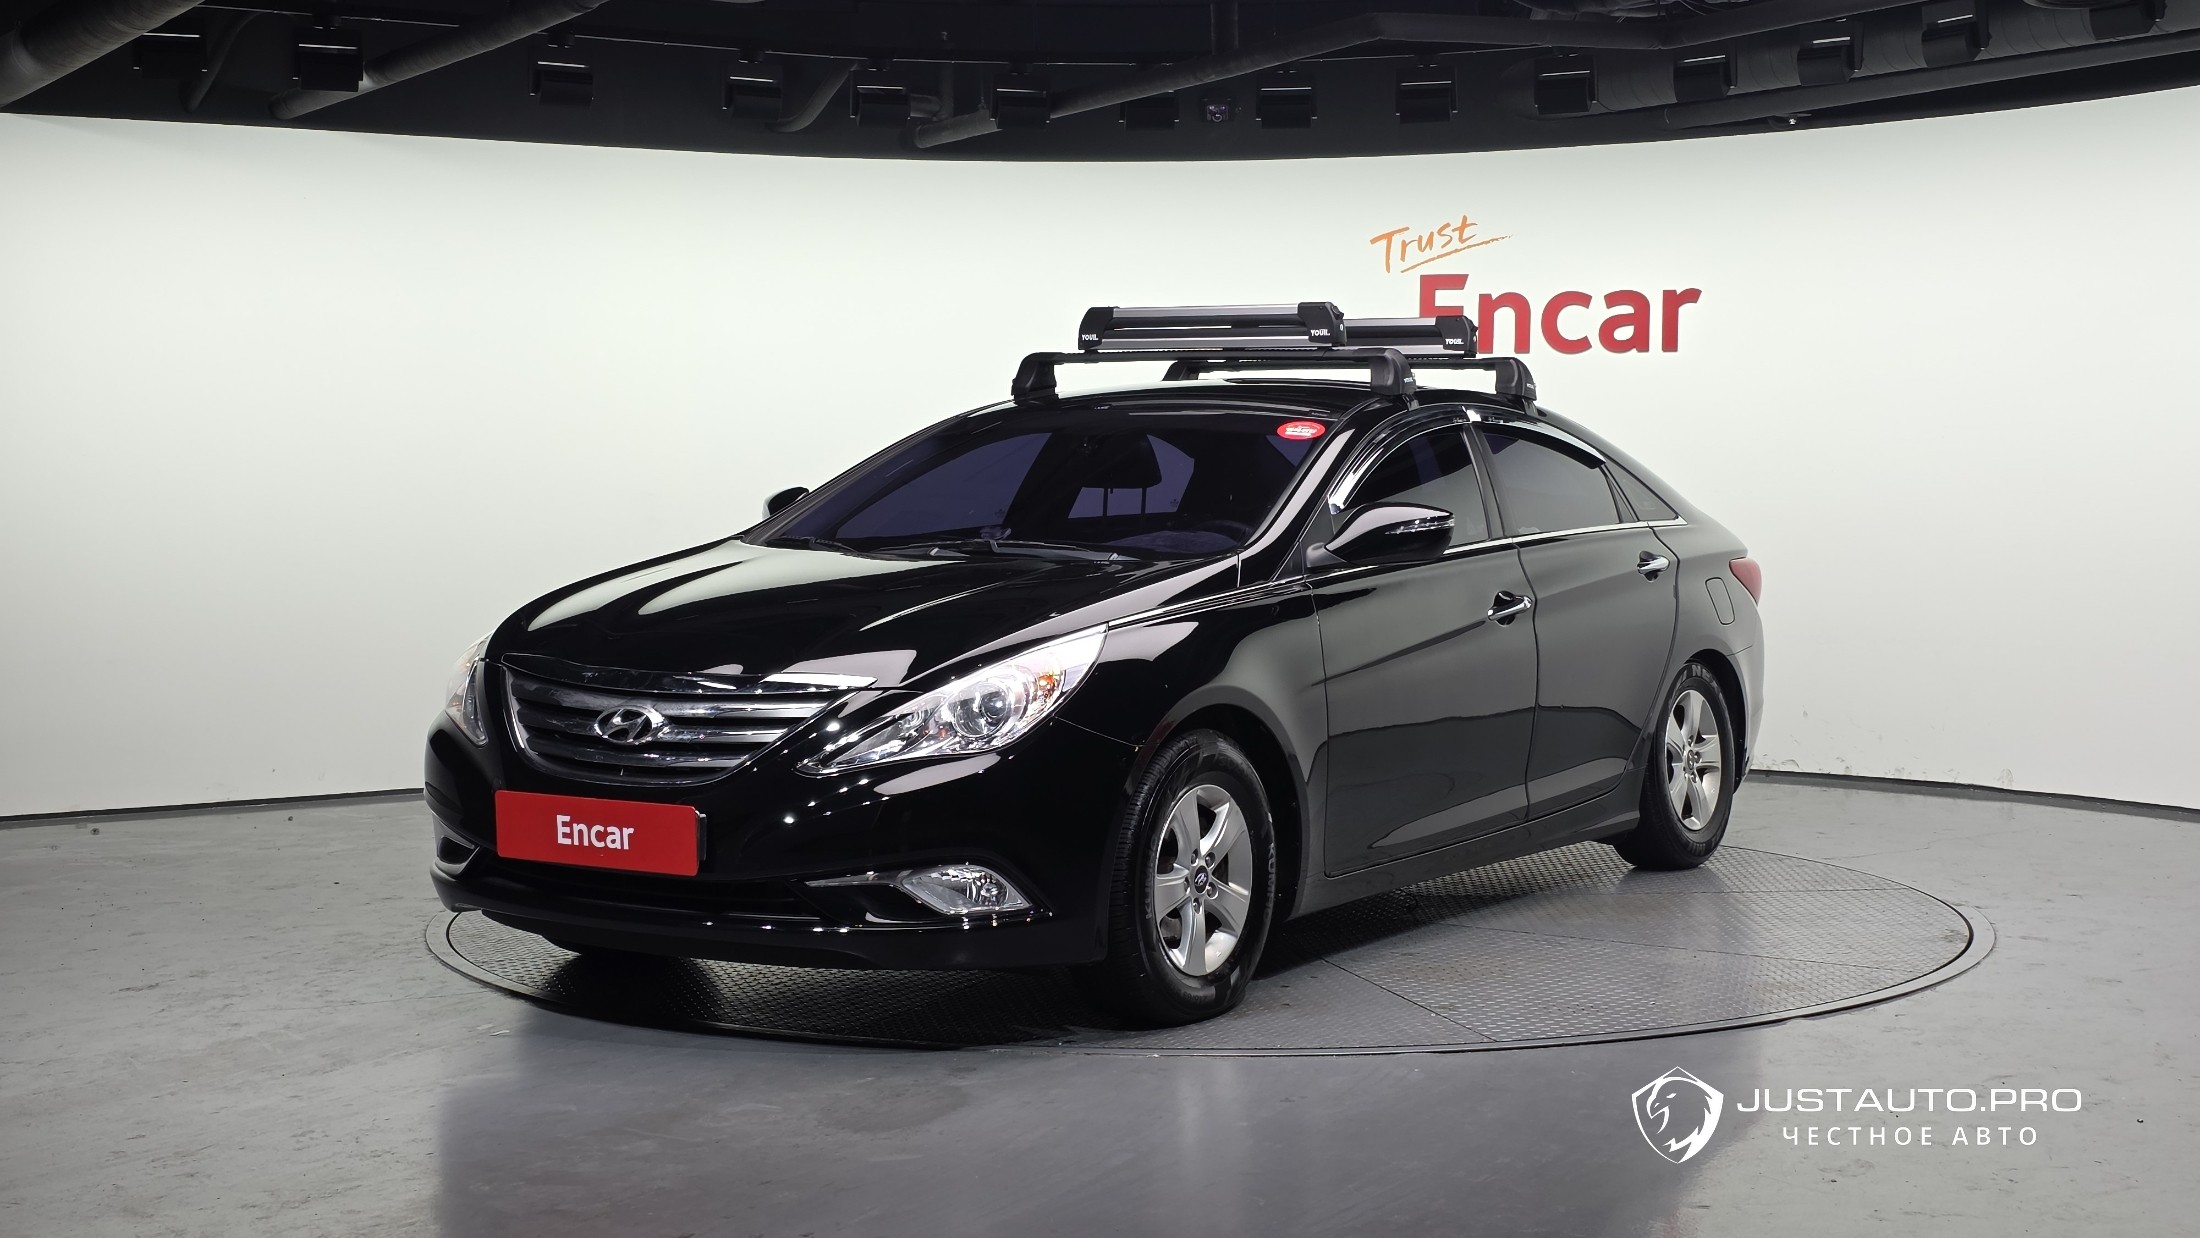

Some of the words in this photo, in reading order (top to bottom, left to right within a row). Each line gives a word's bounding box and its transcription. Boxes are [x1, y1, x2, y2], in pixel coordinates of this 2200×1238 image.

[1370, 214, 1479, 273] Trust
[1419, 273, 1702, 354] Encar
[556, 814, 635, 850] Encar
